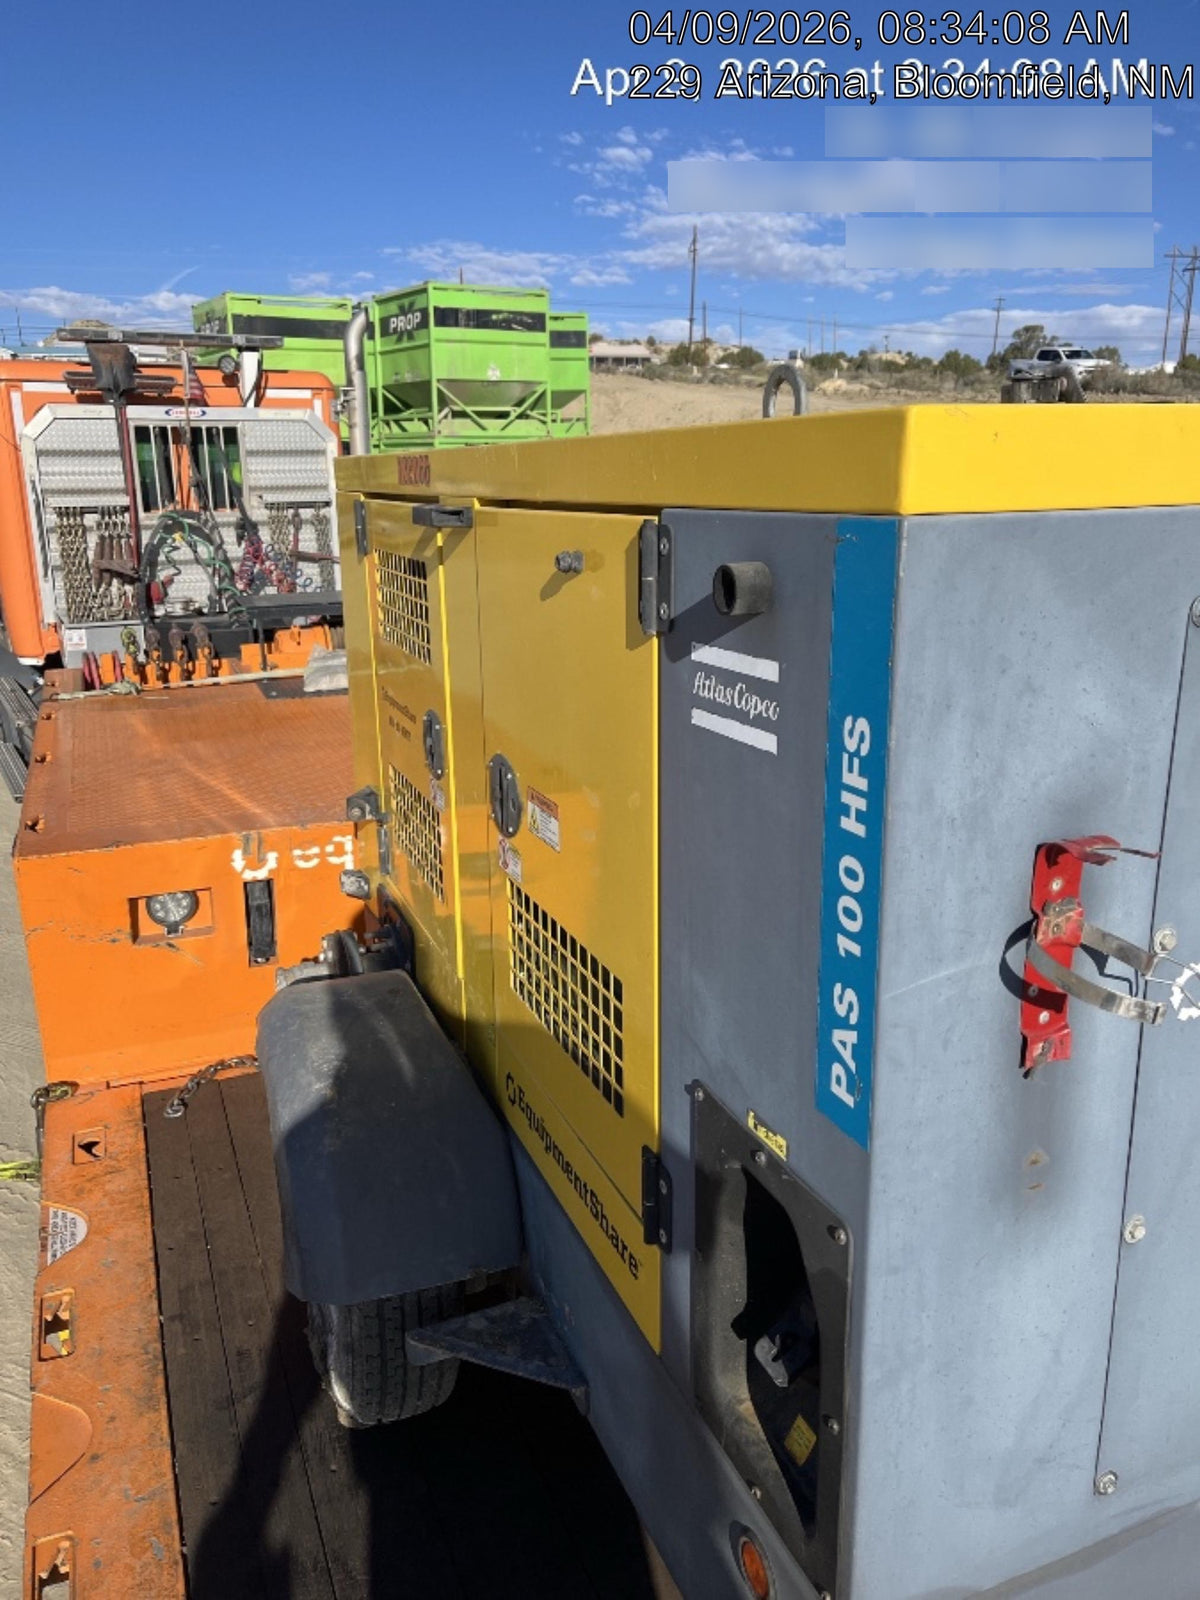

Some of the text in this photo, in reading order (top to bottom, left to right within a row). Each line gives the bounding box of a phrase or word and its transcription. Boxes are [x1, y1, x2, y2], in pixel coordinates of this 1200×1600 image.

[389, 311, 423, 333] PROP
[829, 714, 872, 1110] PAS 100 HFS
[516, 1085, 640, 1281] EquipmentShare
